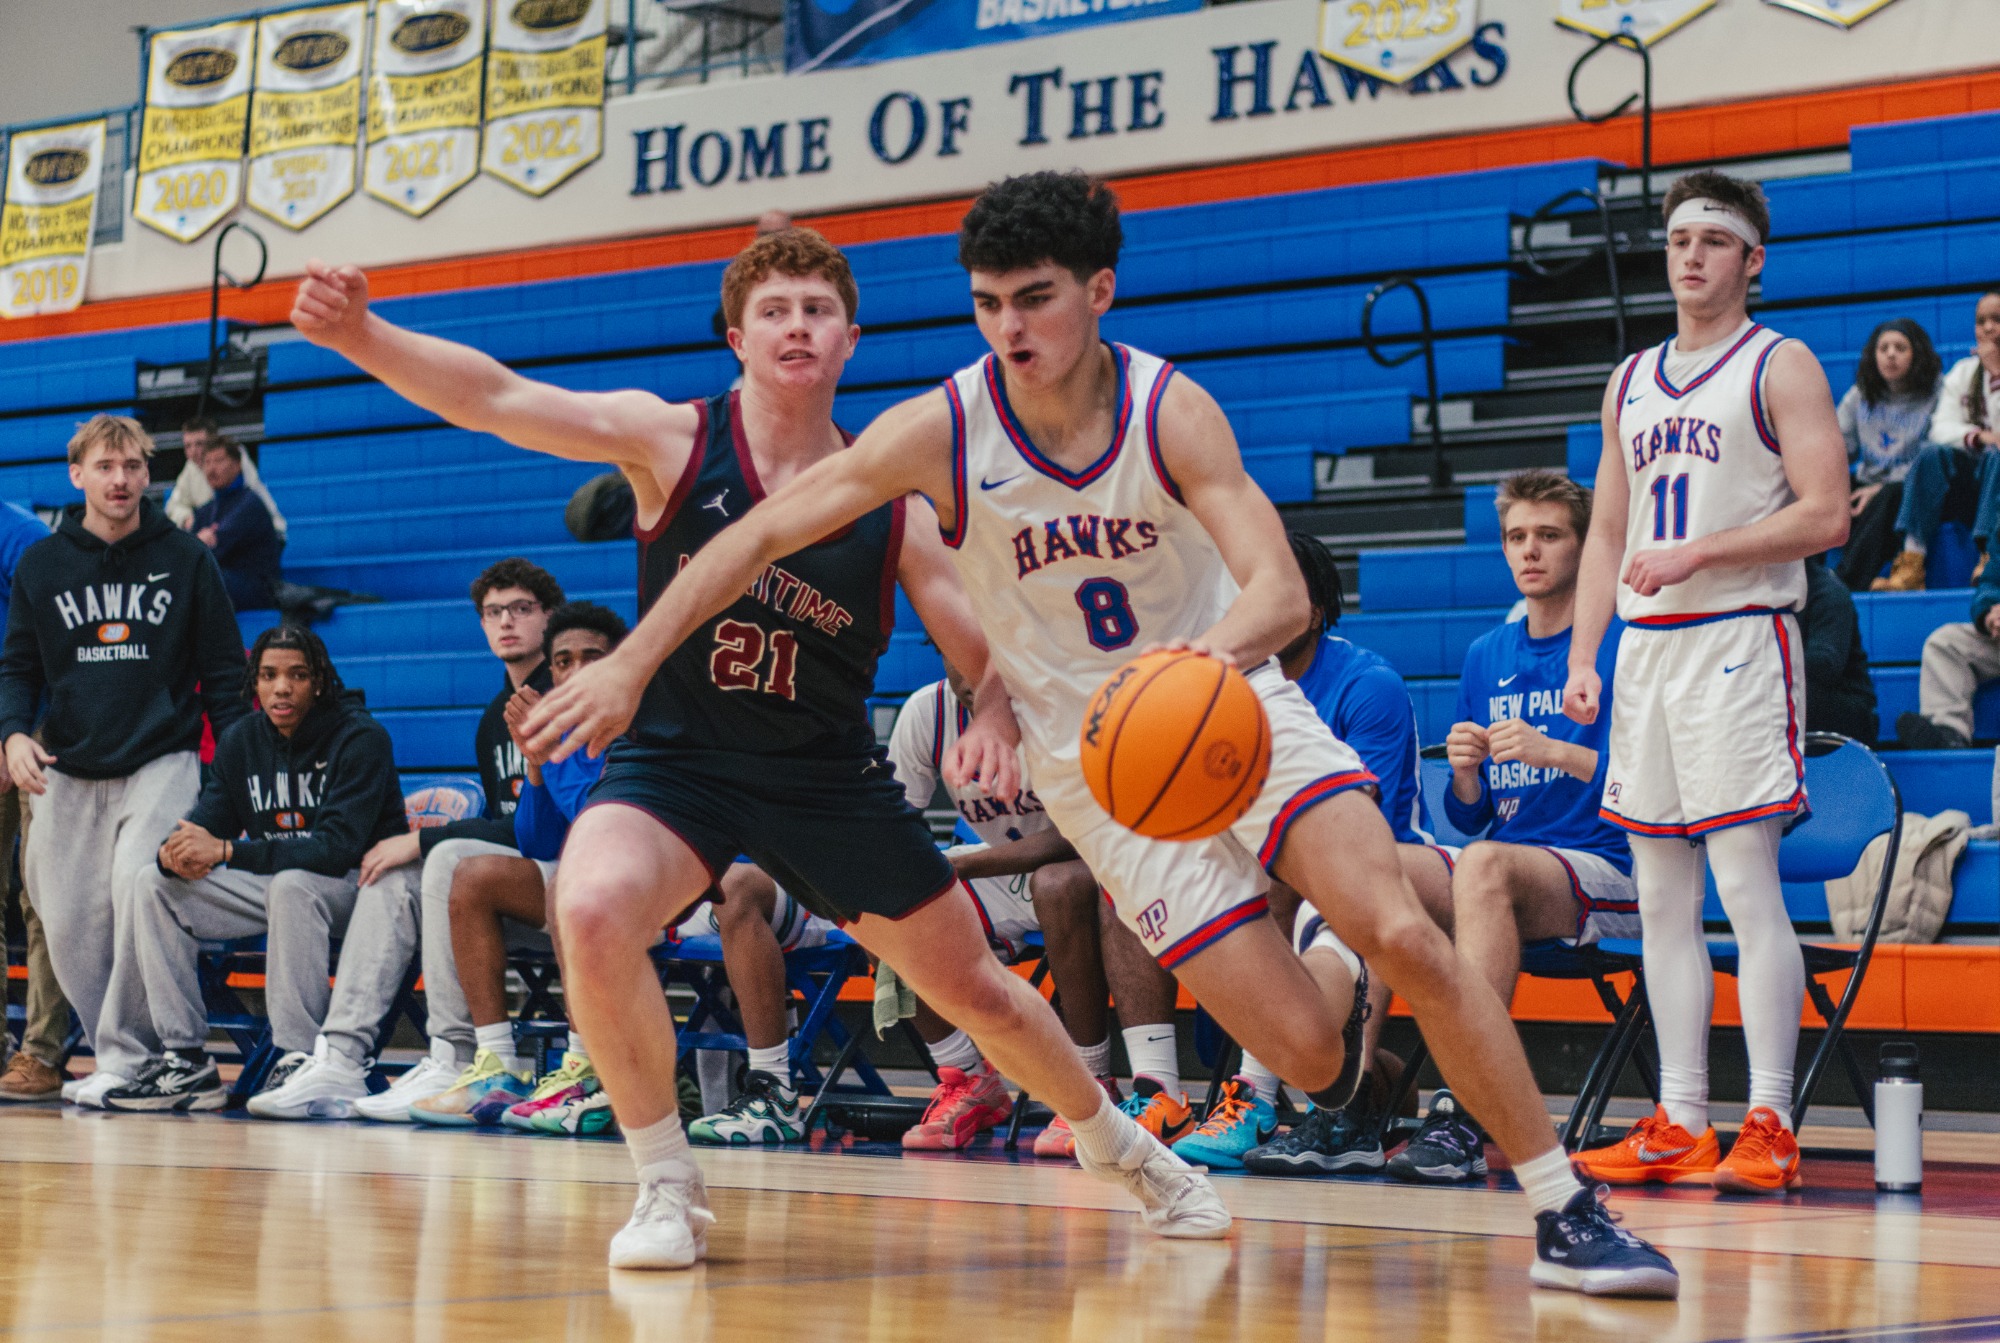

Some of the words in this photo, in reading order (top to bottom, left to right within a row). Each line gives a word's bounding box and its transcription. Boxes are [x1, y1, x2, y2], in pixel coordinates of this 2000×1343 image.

[1344, 0, 1457, 46] 2023
[502, 116, 581, 164] 2022
[629, 117, 831, 196] HOME
[868, 91, 972, 165] OF
[1009, 66, 1166, 148] THE
[384, 137, 455, 182] 2021
[154, 168, 228, 212] 2020
[12, 263, 79, 306] 2019
[1631, 416, 1721, 473] HAWKS
[1650, 473, 1689, 541] 11
[1011, 515, 1159, 580] HAWKS
[55, 583, 172, 630] HAWKS
[1074, 576, 1139, 652] 8
[77, 644, 149, 662] BASKETBALL
[710, 618, 799, 701] 21
[1489, 693, 1524, 722] NEW
[1529, 688, 1566, 717] PAL
[1136, 898, 1168, 943] NP
